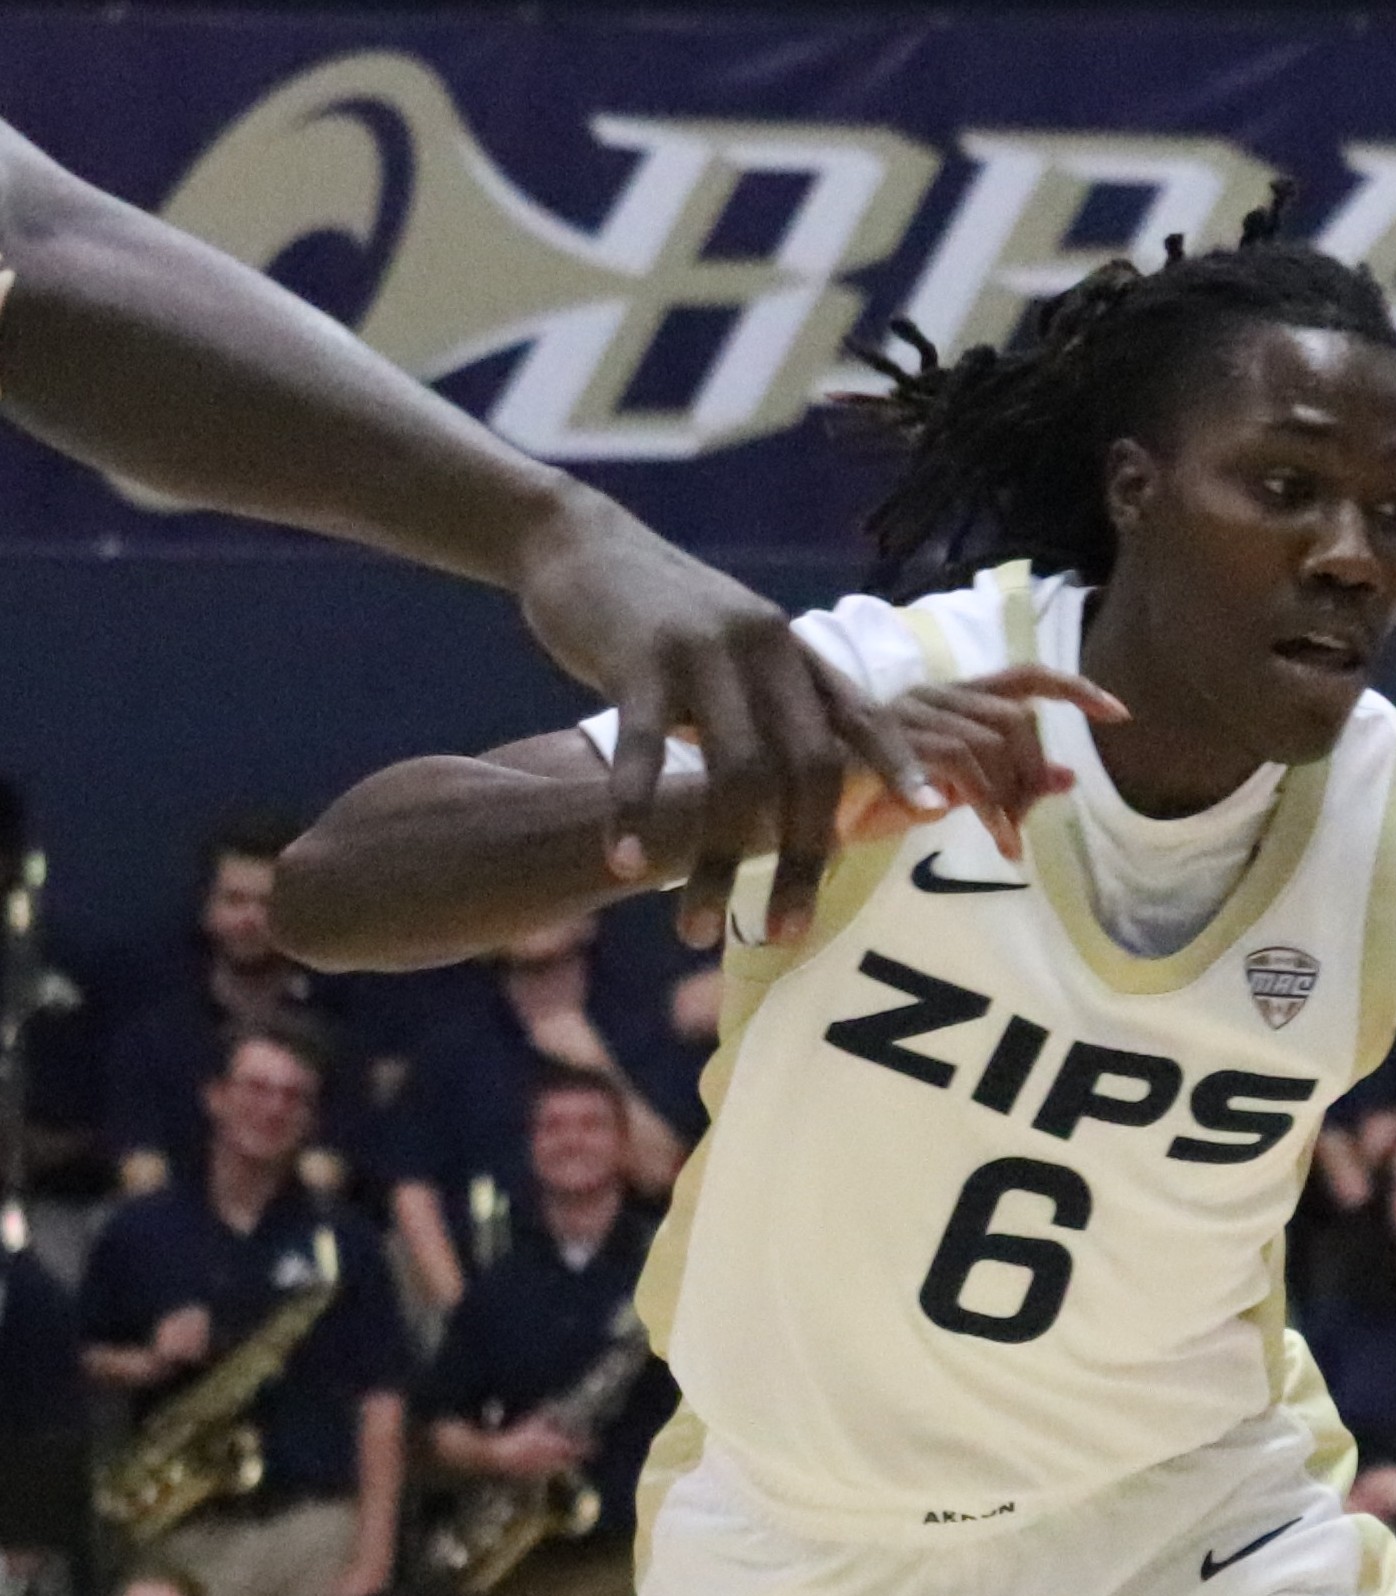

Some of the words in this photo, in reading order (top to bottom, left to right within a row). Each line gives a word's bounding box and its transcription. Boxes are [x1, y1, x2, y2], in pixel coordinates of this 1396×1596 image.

[821, 948, 1320, 1166] ZIPS
[1250, 971, 1314, 997] MAC
[917, 1154, 1095, 1346] 6
